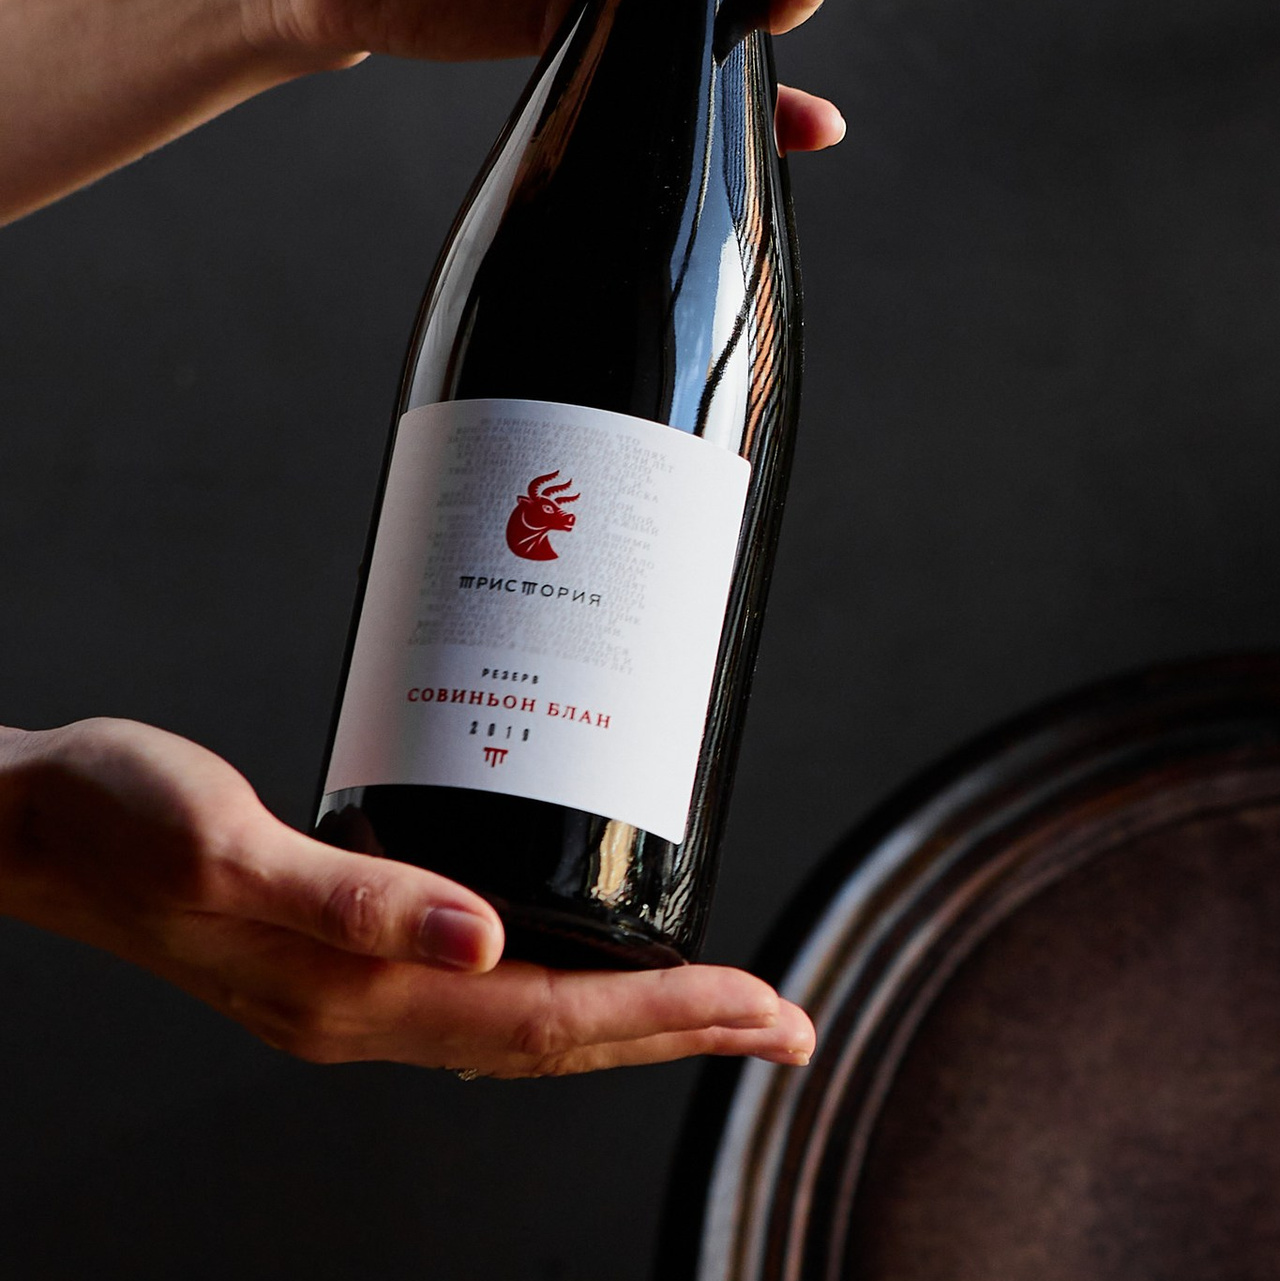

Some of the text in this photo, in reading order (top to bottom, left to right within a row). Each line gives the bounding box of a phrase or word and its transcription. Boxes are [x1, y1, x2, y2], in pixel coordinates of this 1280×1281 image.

[481, 668, 540, 685] РЕЗЕРВ
[407, 687, 612, 729] СОВИНЬОН БЛАН
